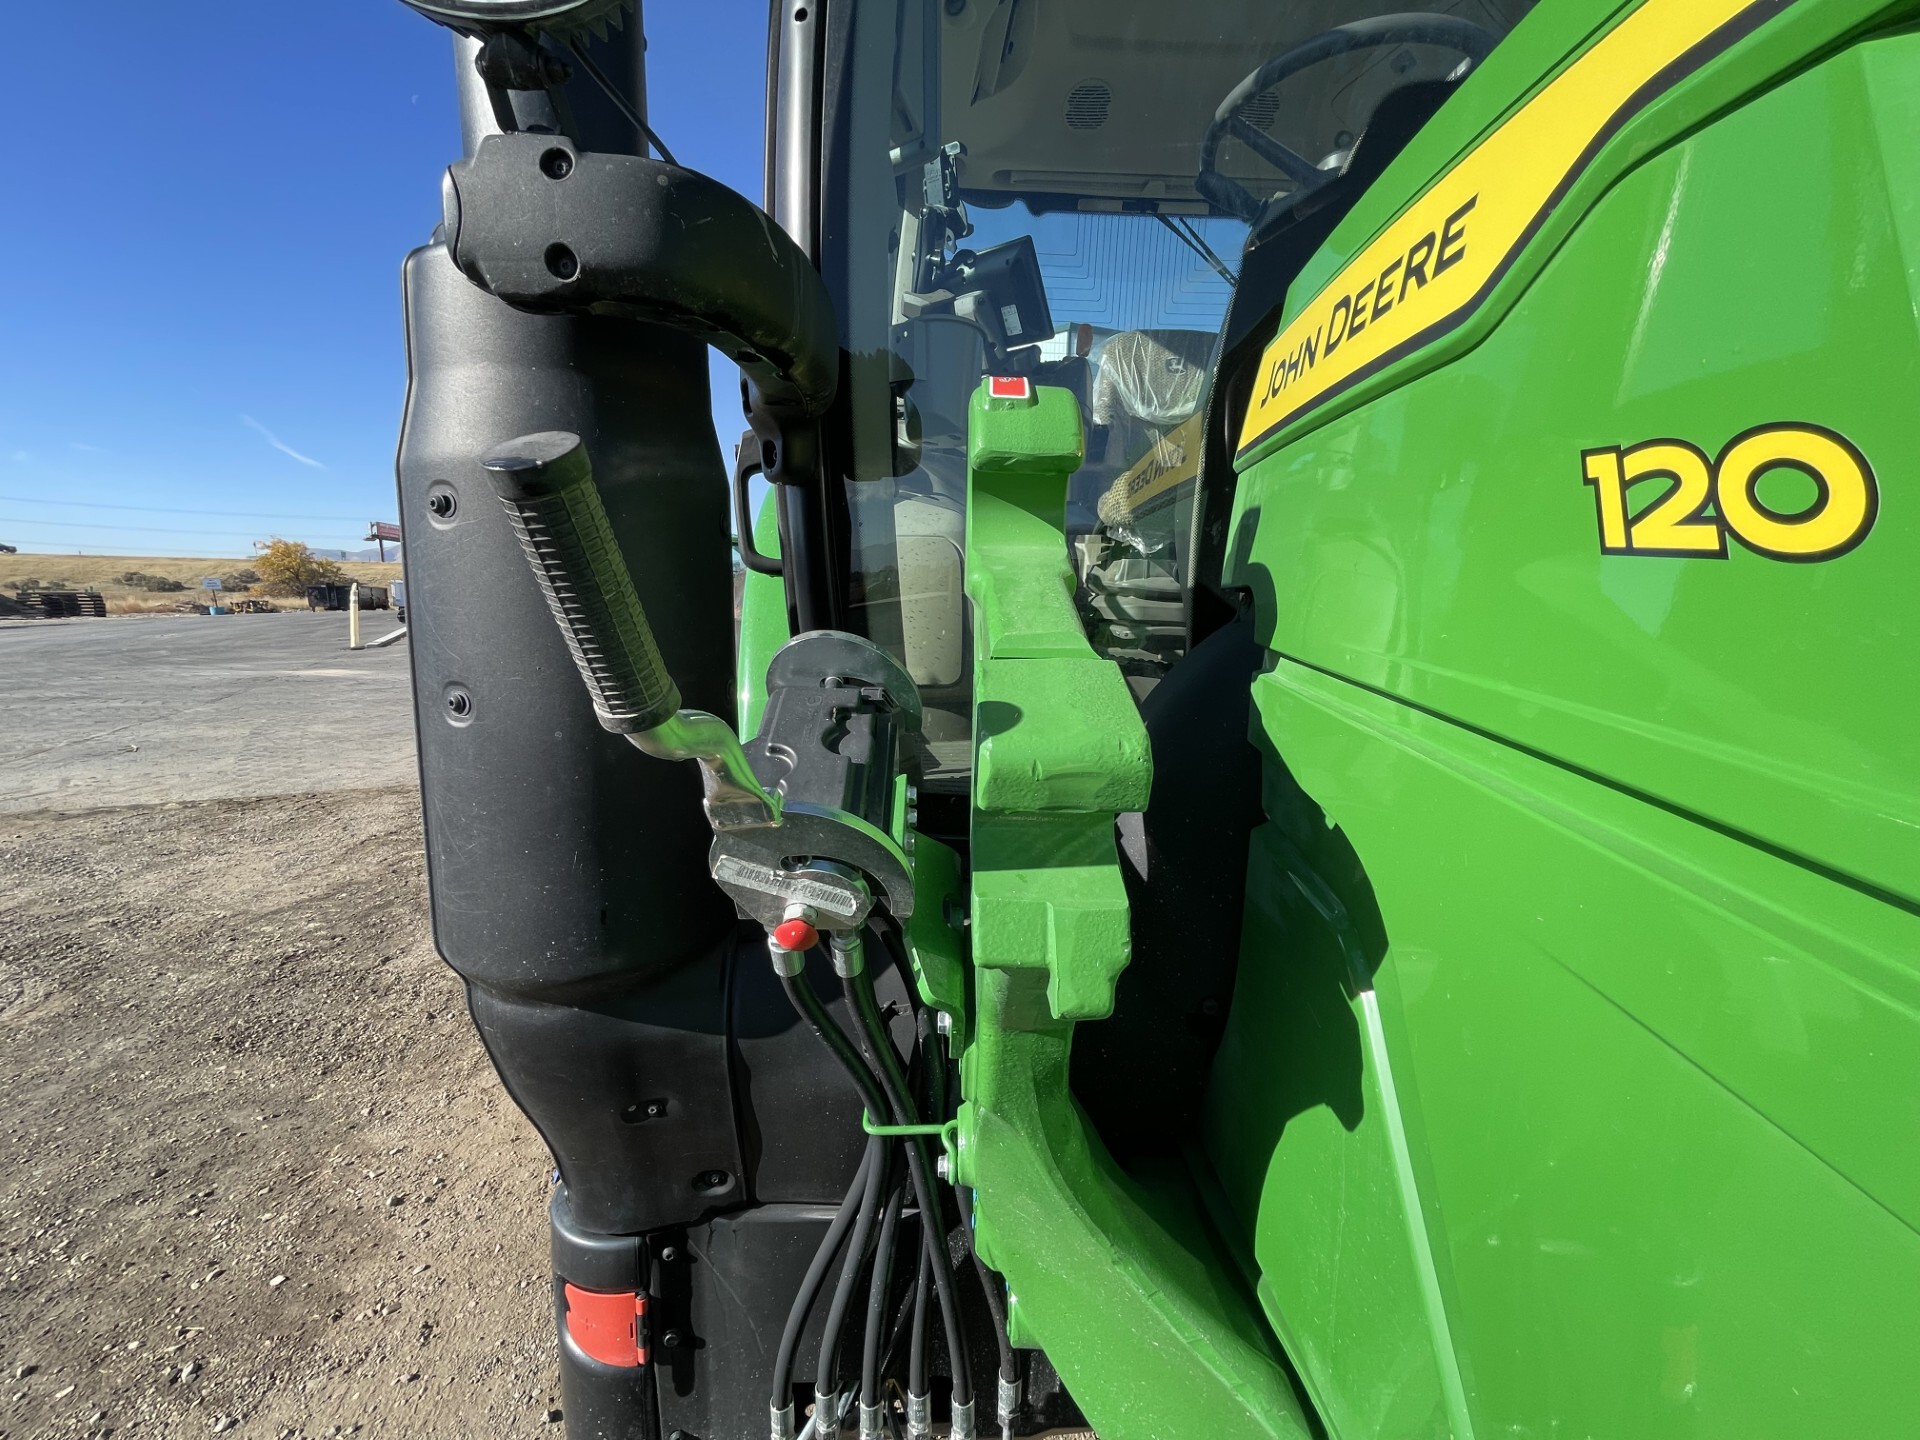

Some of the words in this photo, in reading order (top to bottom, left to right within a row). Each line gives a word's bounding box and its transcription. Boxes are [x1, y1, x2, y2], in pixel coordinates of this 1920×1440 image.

[1260, 324, 1323, 409] JOHN
[1323, 192, 1479, 360] DEERE
[1580, 421, 1879, 564] 120
